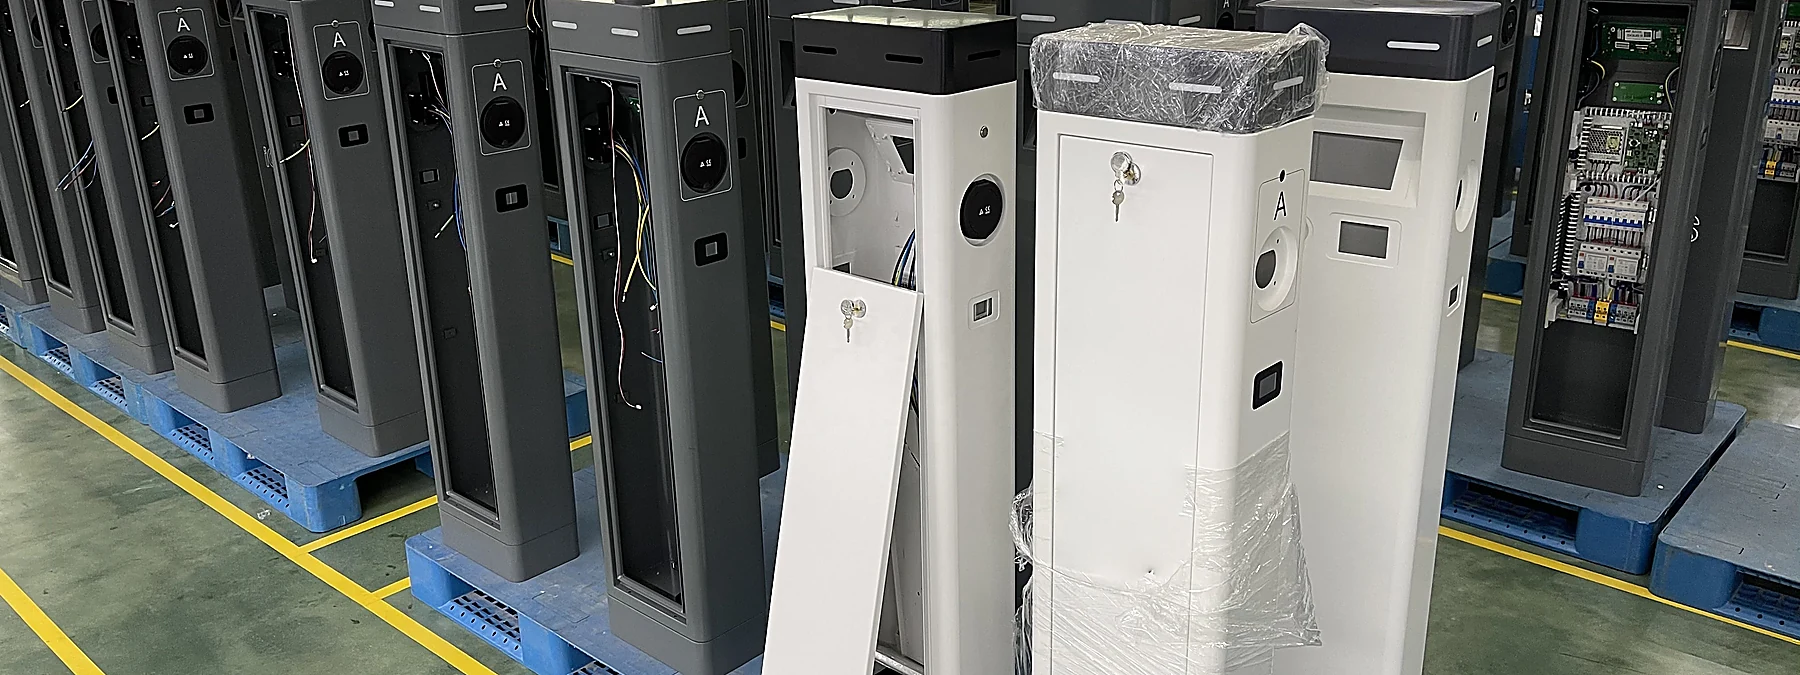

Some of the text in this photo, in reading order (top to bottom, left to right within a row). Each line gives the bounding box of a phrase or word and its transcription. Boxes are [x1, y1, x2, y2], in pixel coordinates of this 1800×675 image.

[177, 18, 190, 32] A
[334, 32, 347, 47] A
[493, 72, 507, 91] A
[695, 105, 710, 127] A
[1273, 191, 1287, 220] A
